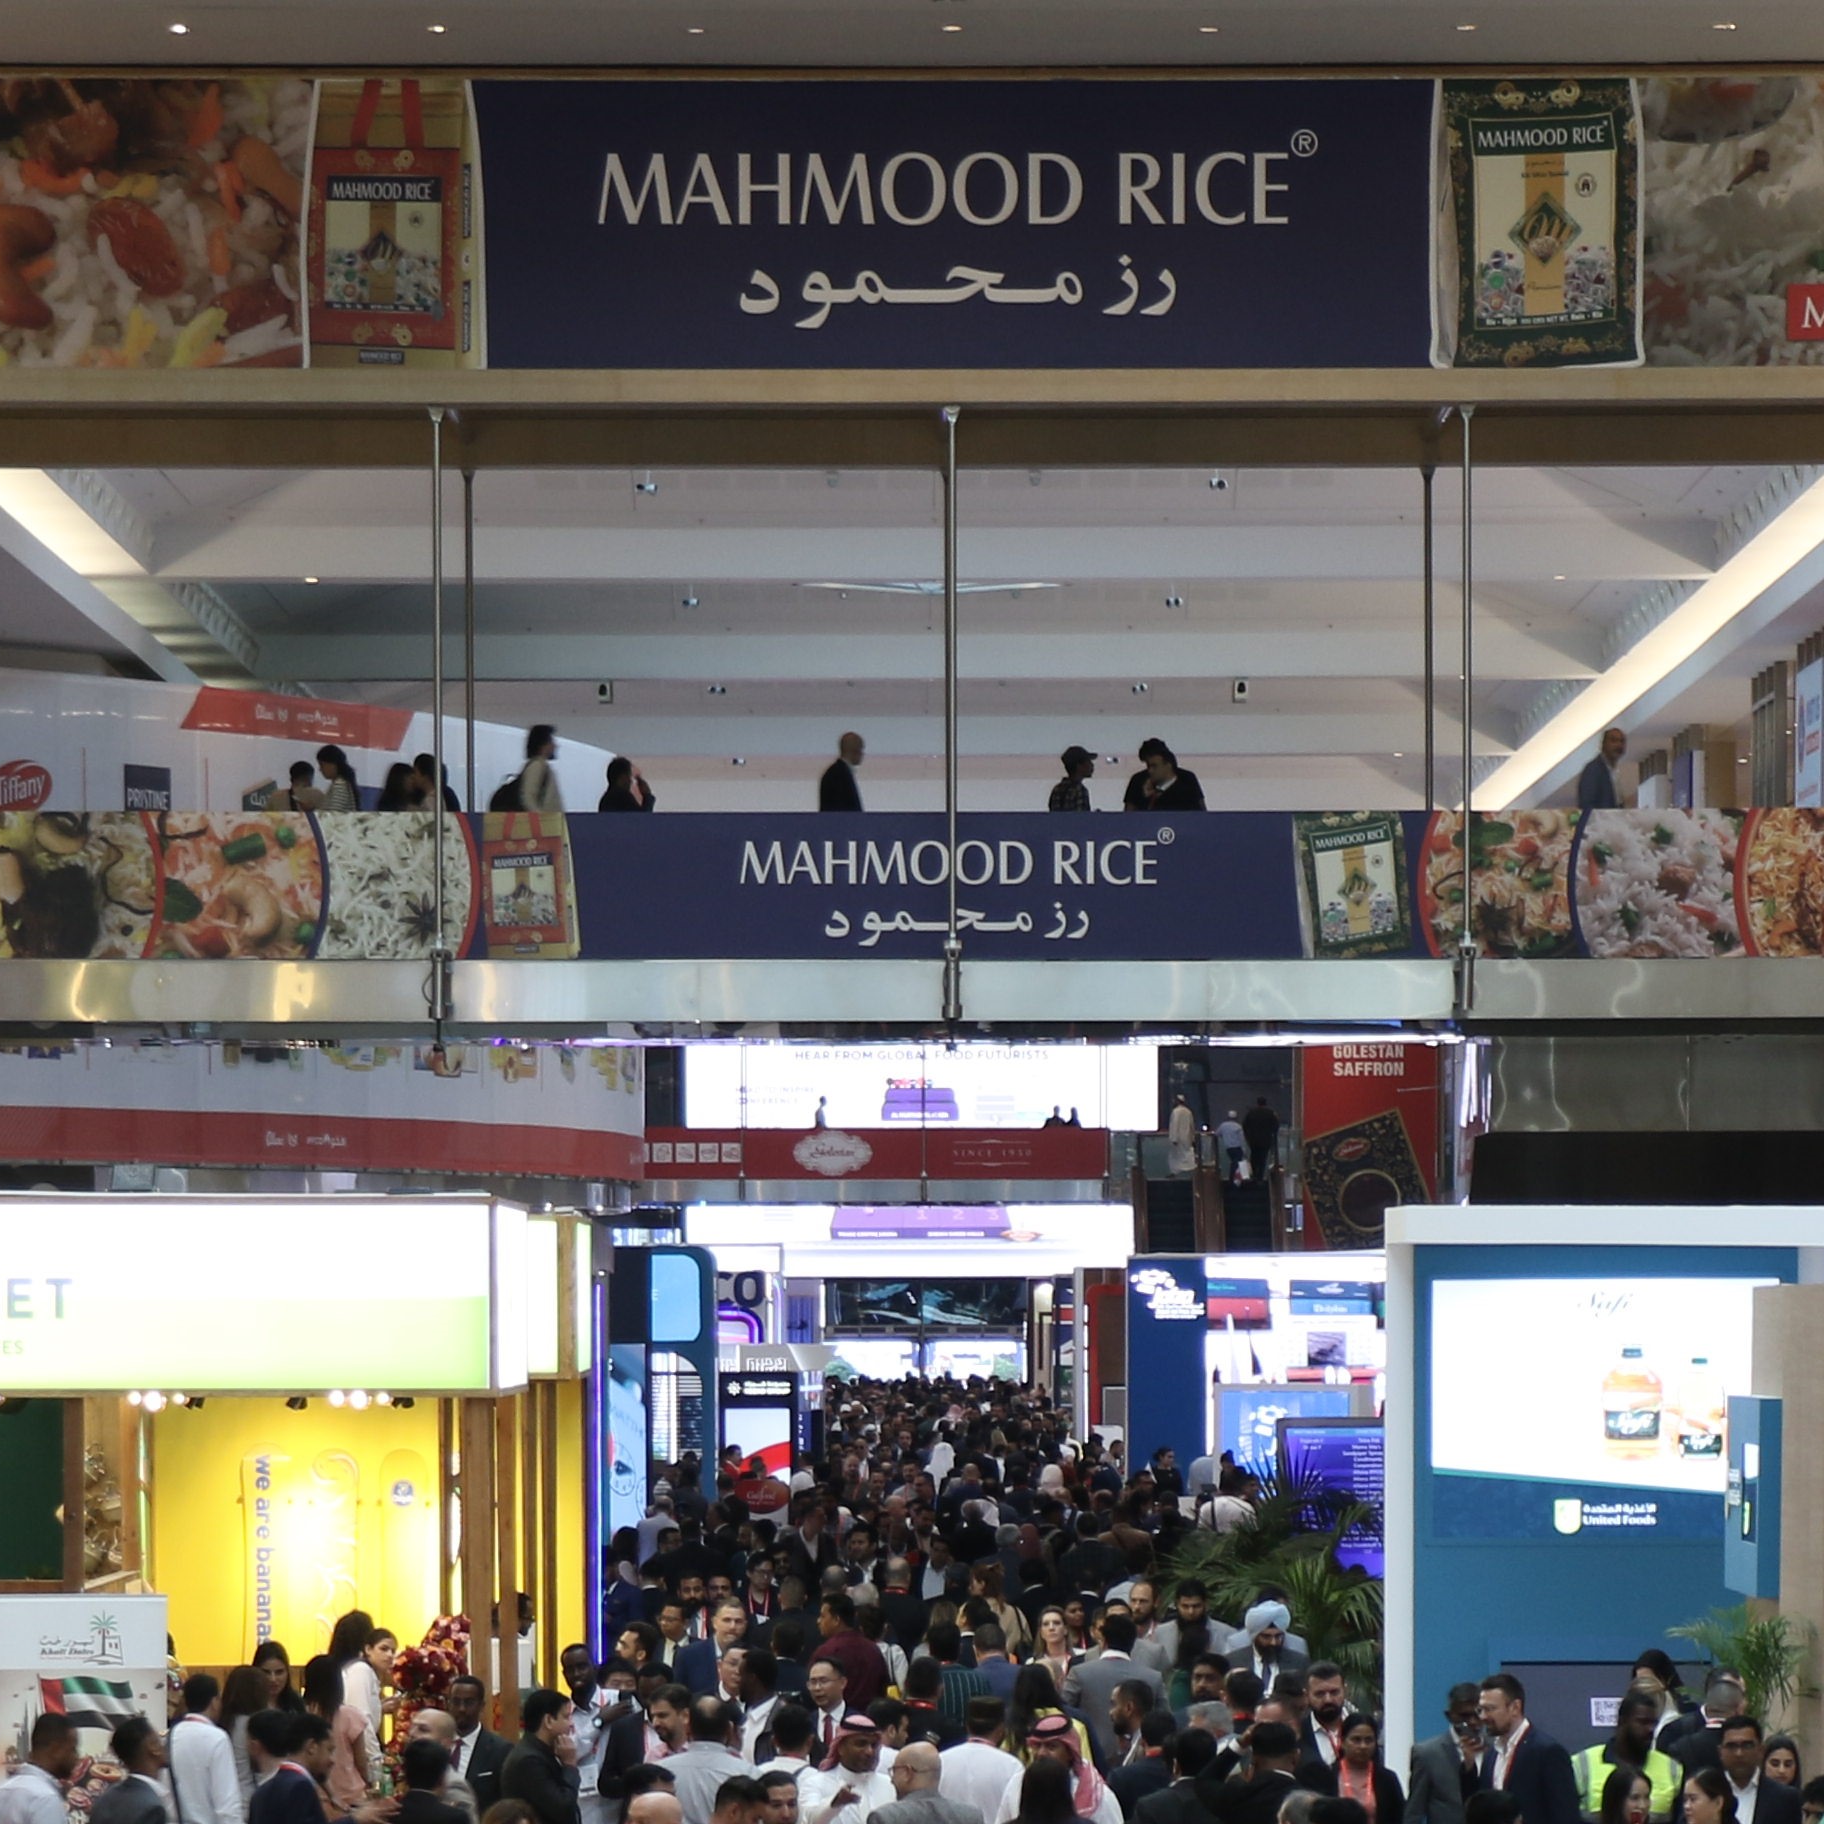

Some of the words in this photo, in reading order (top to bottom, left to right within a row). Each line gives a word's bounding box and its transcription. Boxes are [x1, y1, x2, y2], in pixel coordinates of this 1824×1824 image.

[1478, 128, 1569, 149] MAHMOOD
[1572, 122, 1605, 146] RICE
[332, 181, 402, 201] MAHMOOD
[405, 182, 432, 200] RICE
[597, 152, 1083, 225] MAHMOOD
[740, 264, 1083, 329] محمود
[1102, 254, 1177, 315] رز
[127, 789, 169, 810] PRISTINE
[1315, 833, 1365, 850] MAHMOOD
[493, 856, 532, 869] MAHMOOD
[739, 840, 1033, 885] MAHMOOD
[1044, 902, 1090, 940] رز
[835, 1050, 873, 1061] FROM
[1333, 1044, 1405, 1059] GOLESTAN
[1333, 1061, 1405, 1077] SAFFRON
[256, 1455, 273, 1491] we
[256, 1498, 271, 1540] are
[1582, 1515, 1623, 1526] United
[1624, 1515, 1657, 1526] Foods
